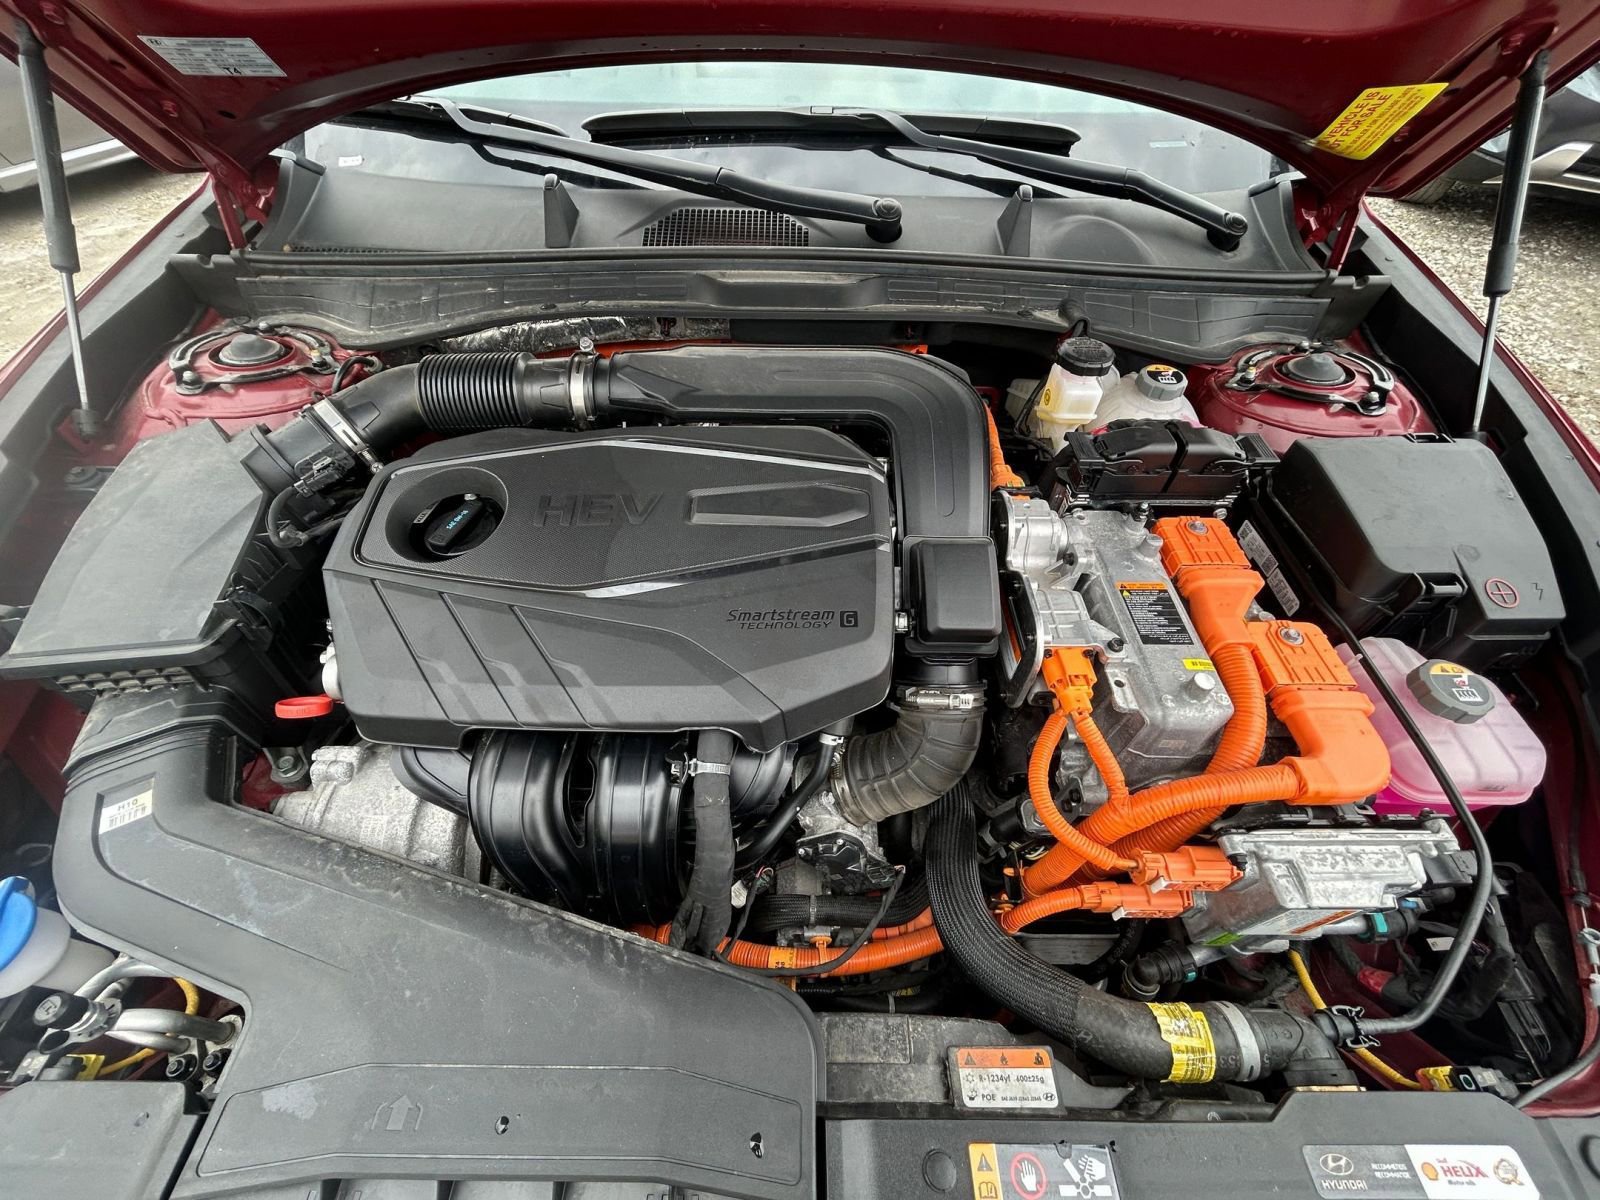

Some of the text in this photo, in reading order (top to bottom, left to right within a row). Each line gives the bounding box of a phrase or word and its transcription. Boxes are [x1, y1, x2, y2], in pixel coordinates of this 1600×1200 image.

[1324, 102, 1369, 139] VEHICLE
[1363, 91, 1381, 101] IS
[1340, 119, 1367, 137] FOR
[1360, 94, 1393, 117] SALE
[533, 492, 664, 527] HEV
[726, 608, 856, 626] Smartstream G
[739, 621, 832, 629] TECHNOLOGY
[981, 1093, 996, 1101] POE
[1440, 1165, 1488, 1178] HELIX
[1321, 1179, 1368, 1191] HYUNDAI
